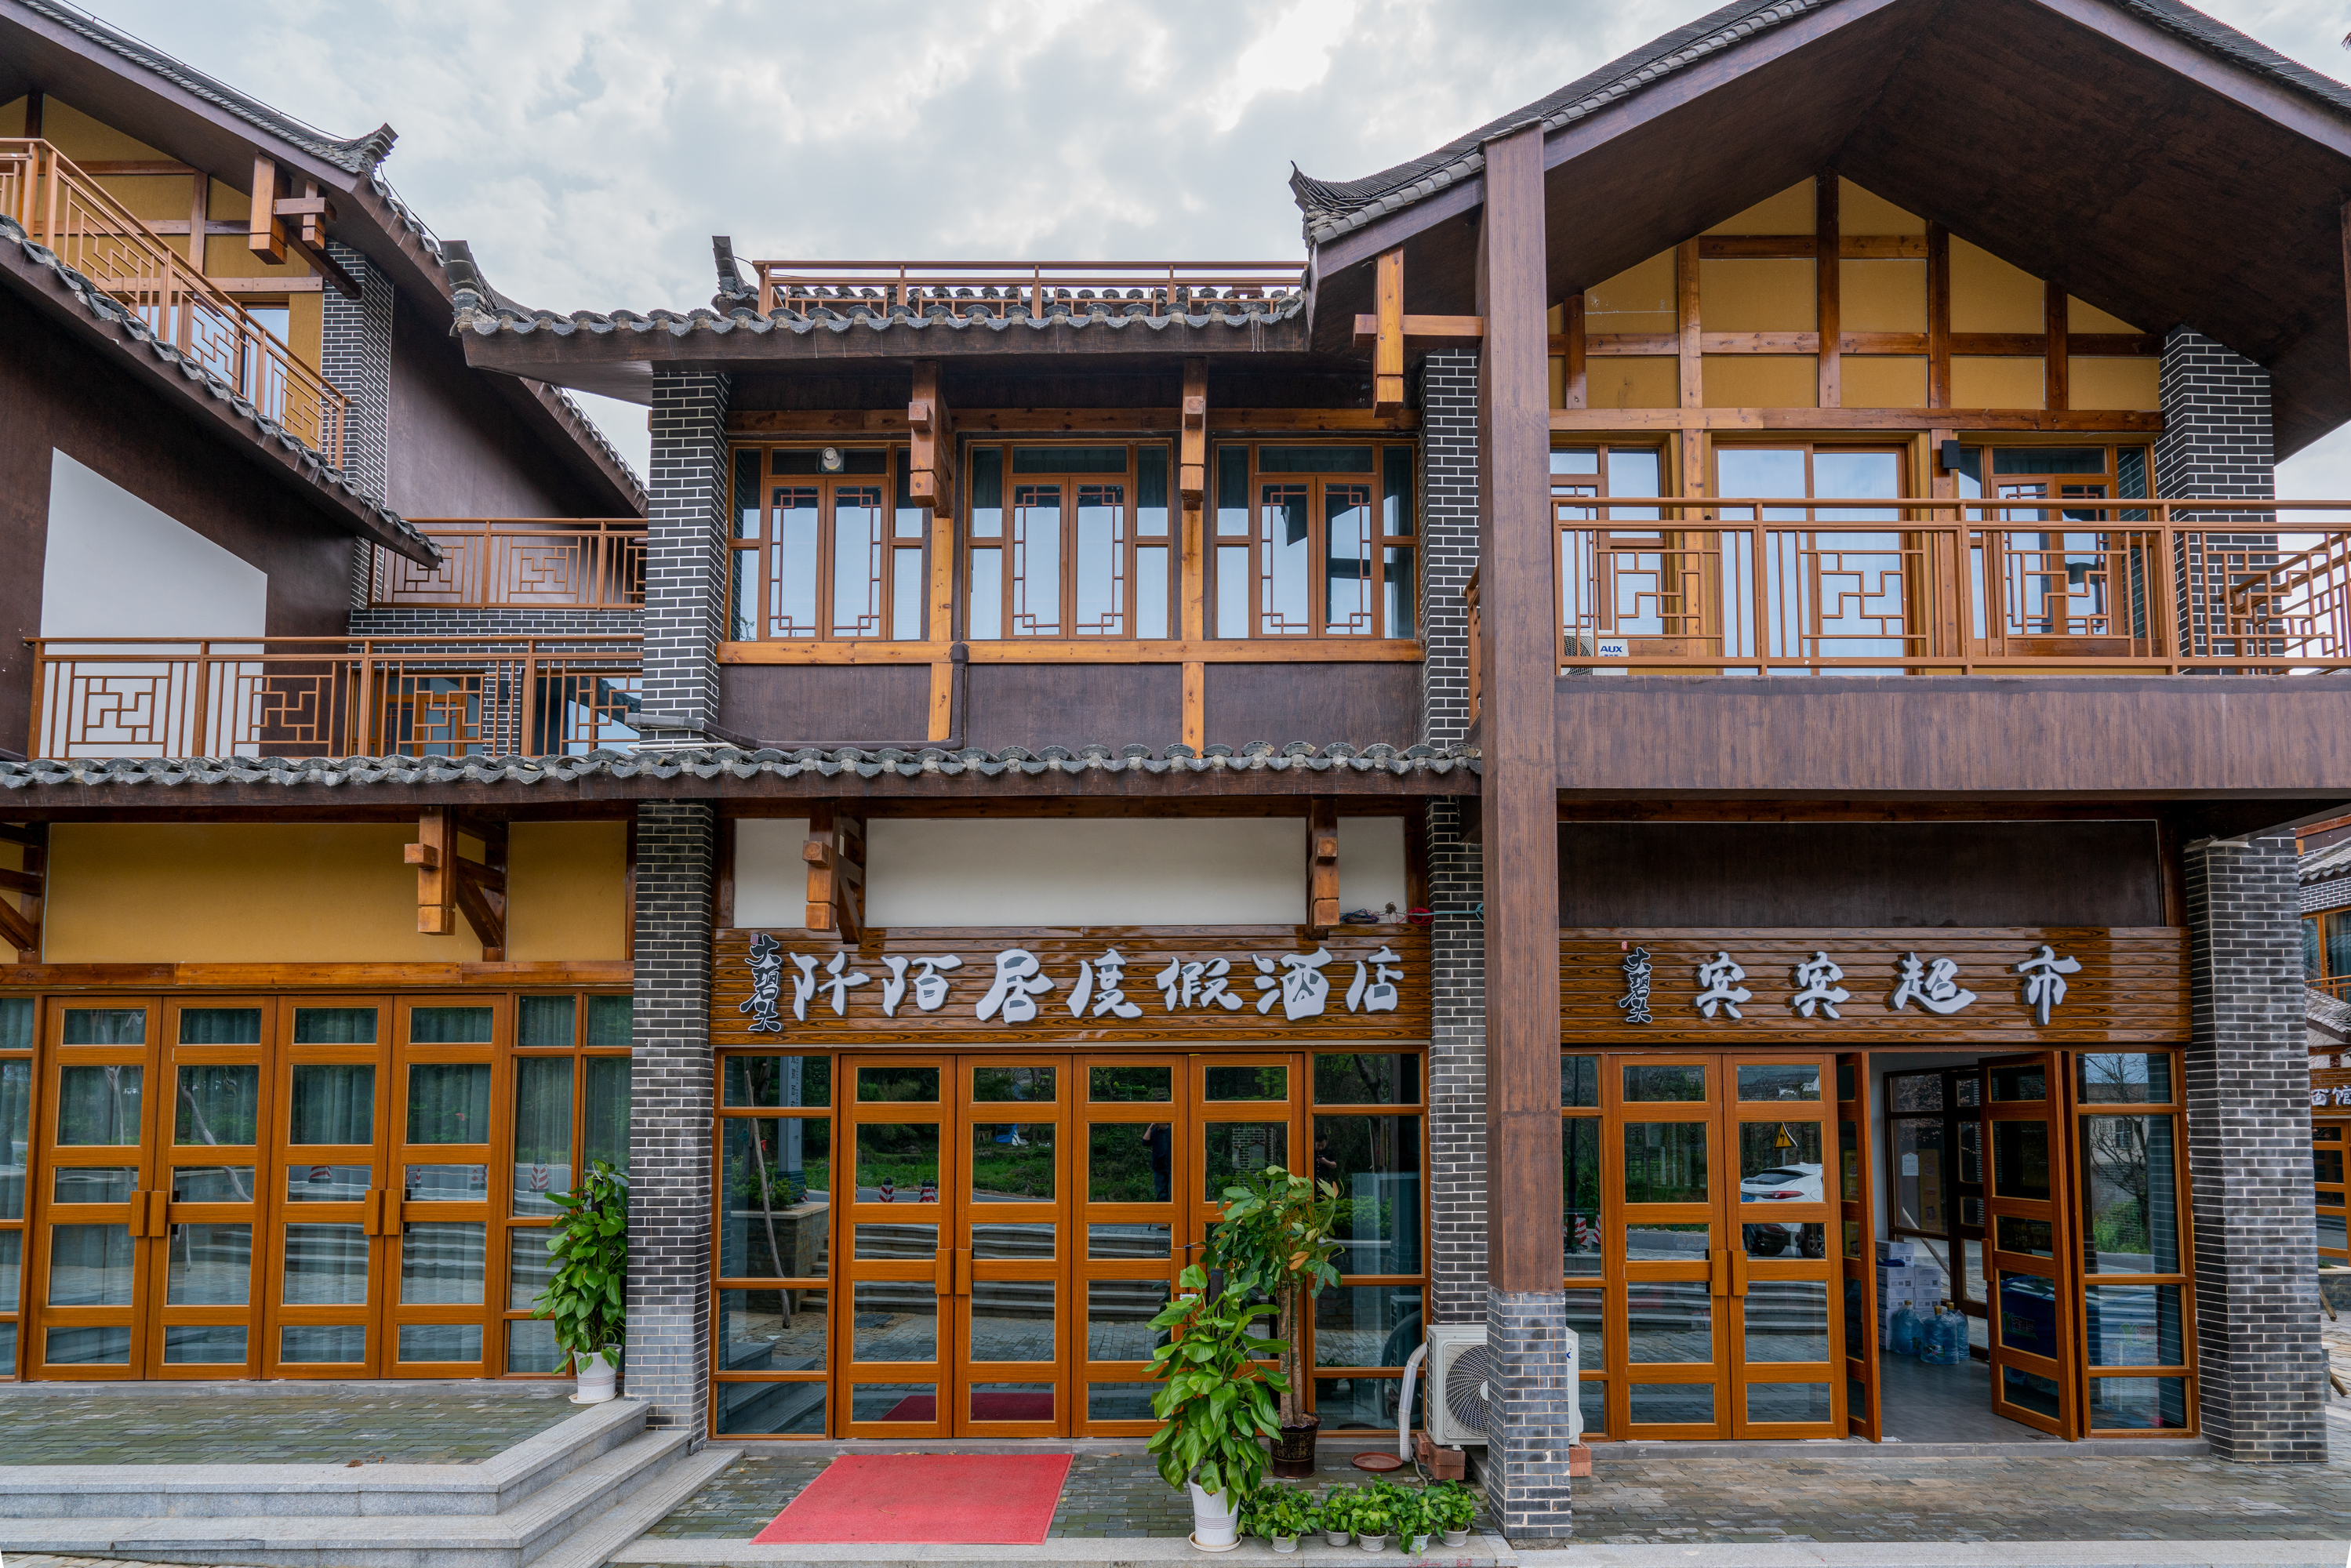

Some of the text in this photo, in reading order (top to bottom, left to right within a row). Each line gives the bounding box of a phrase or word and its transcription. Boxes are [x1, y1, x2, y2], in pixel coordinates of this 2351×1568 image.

[788, 944, 1404, 1025] 阡陌居度假酒店
[1693, 945, 2082, 1025] 宾宾超市
